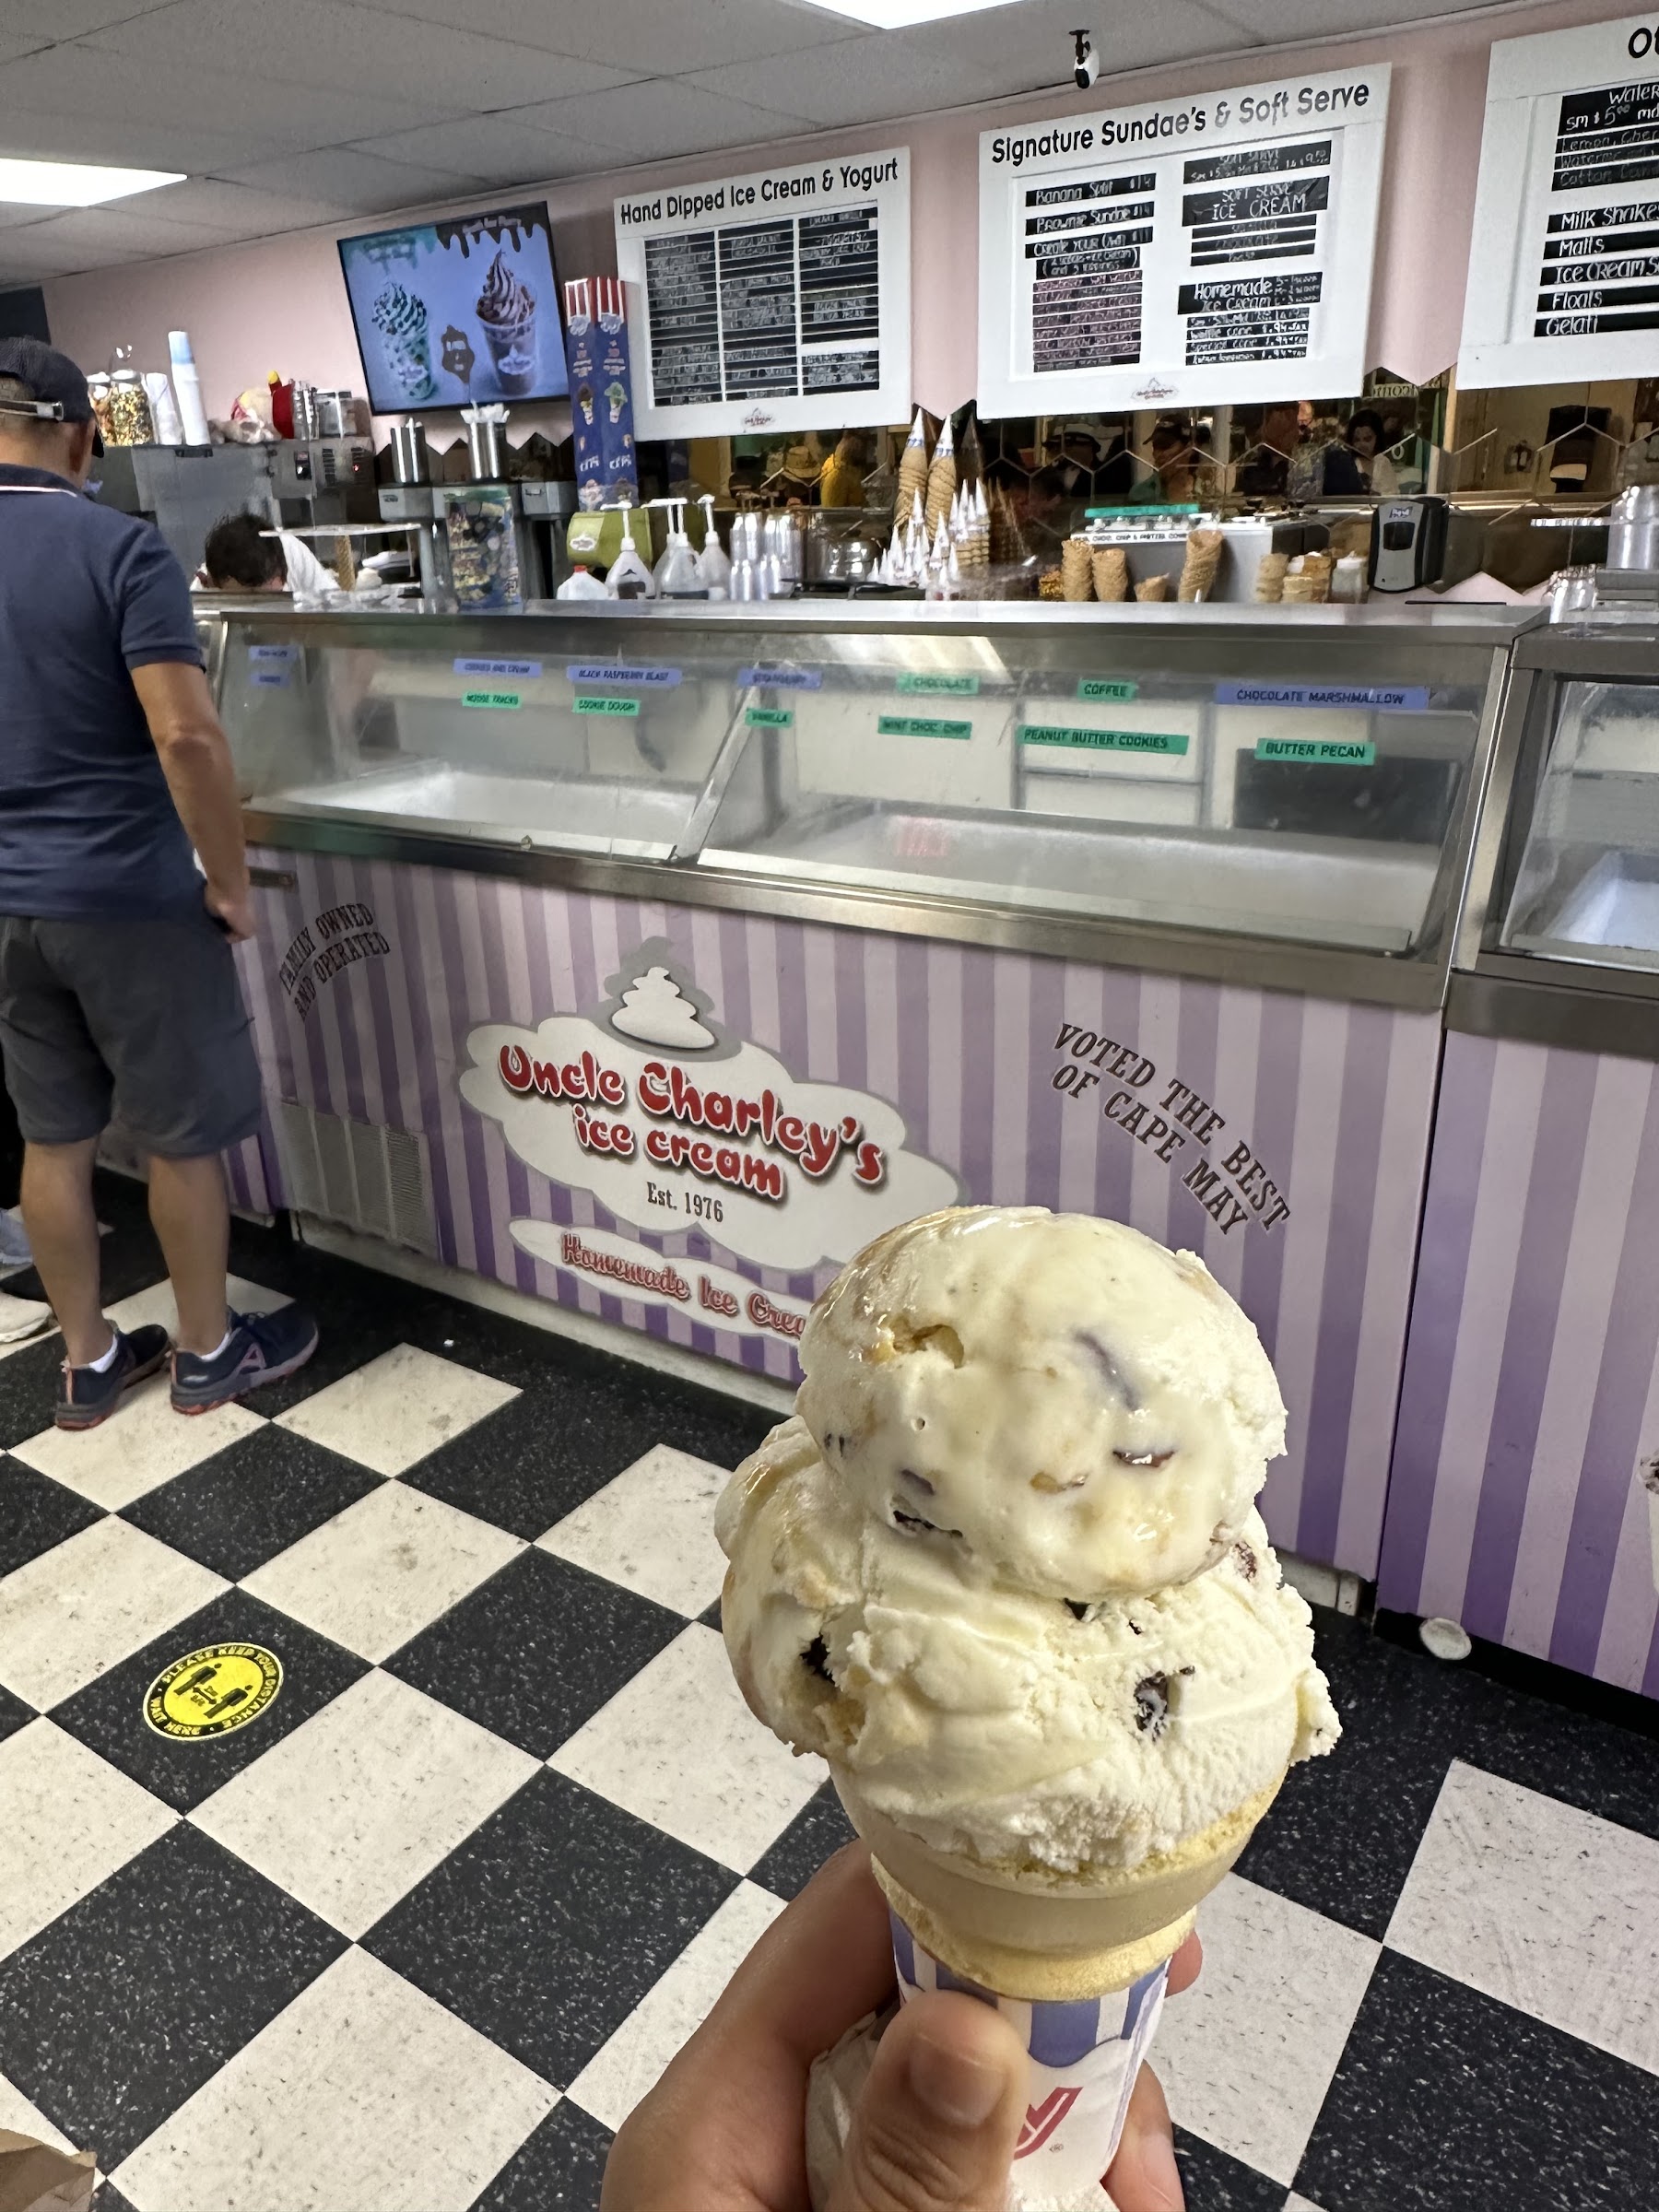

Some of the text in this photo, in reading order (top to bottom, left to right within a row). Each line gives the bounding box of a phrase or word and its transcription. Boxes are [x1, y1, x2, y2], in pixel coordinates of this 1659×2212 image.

[992, 84, 1370, 167] Signature Sundae's & Soft Serve
[620, 157, 899, 226] Hand Dipped Ice Cream & Yogurt
[1249, 192, 1307, 218] CREAM
[1561, 203, 1659, 230] Milk Shake
[1559, 235, 1606, 257] Malts
[1553, 265, 1584, 285] Ice
[1552, 290, 1603, 311] Floats
[1083, 683, 1129, 698] COFFEE
[1236, 689, 1406, 705] CHOCOLATE MARSHMALLOW
[1024, 728, 1169, 750] PEANUT BUTTER COOKIES
[1265, 741, 1366, 759] BUTTER PECAN
[499, 1044, 887, 1184] Uncle Charley's
[1053, 1022, 1291, 1231] VOTED THE BEST
[572, 1102, 784, 1201] ice cream
[1051, 1065, 1249, 1236] OF CAPE MAY
[647, 1182, 724, 1223] Est. 1976
[561, 1231, 807, 1337] Homemade Ice Crea
